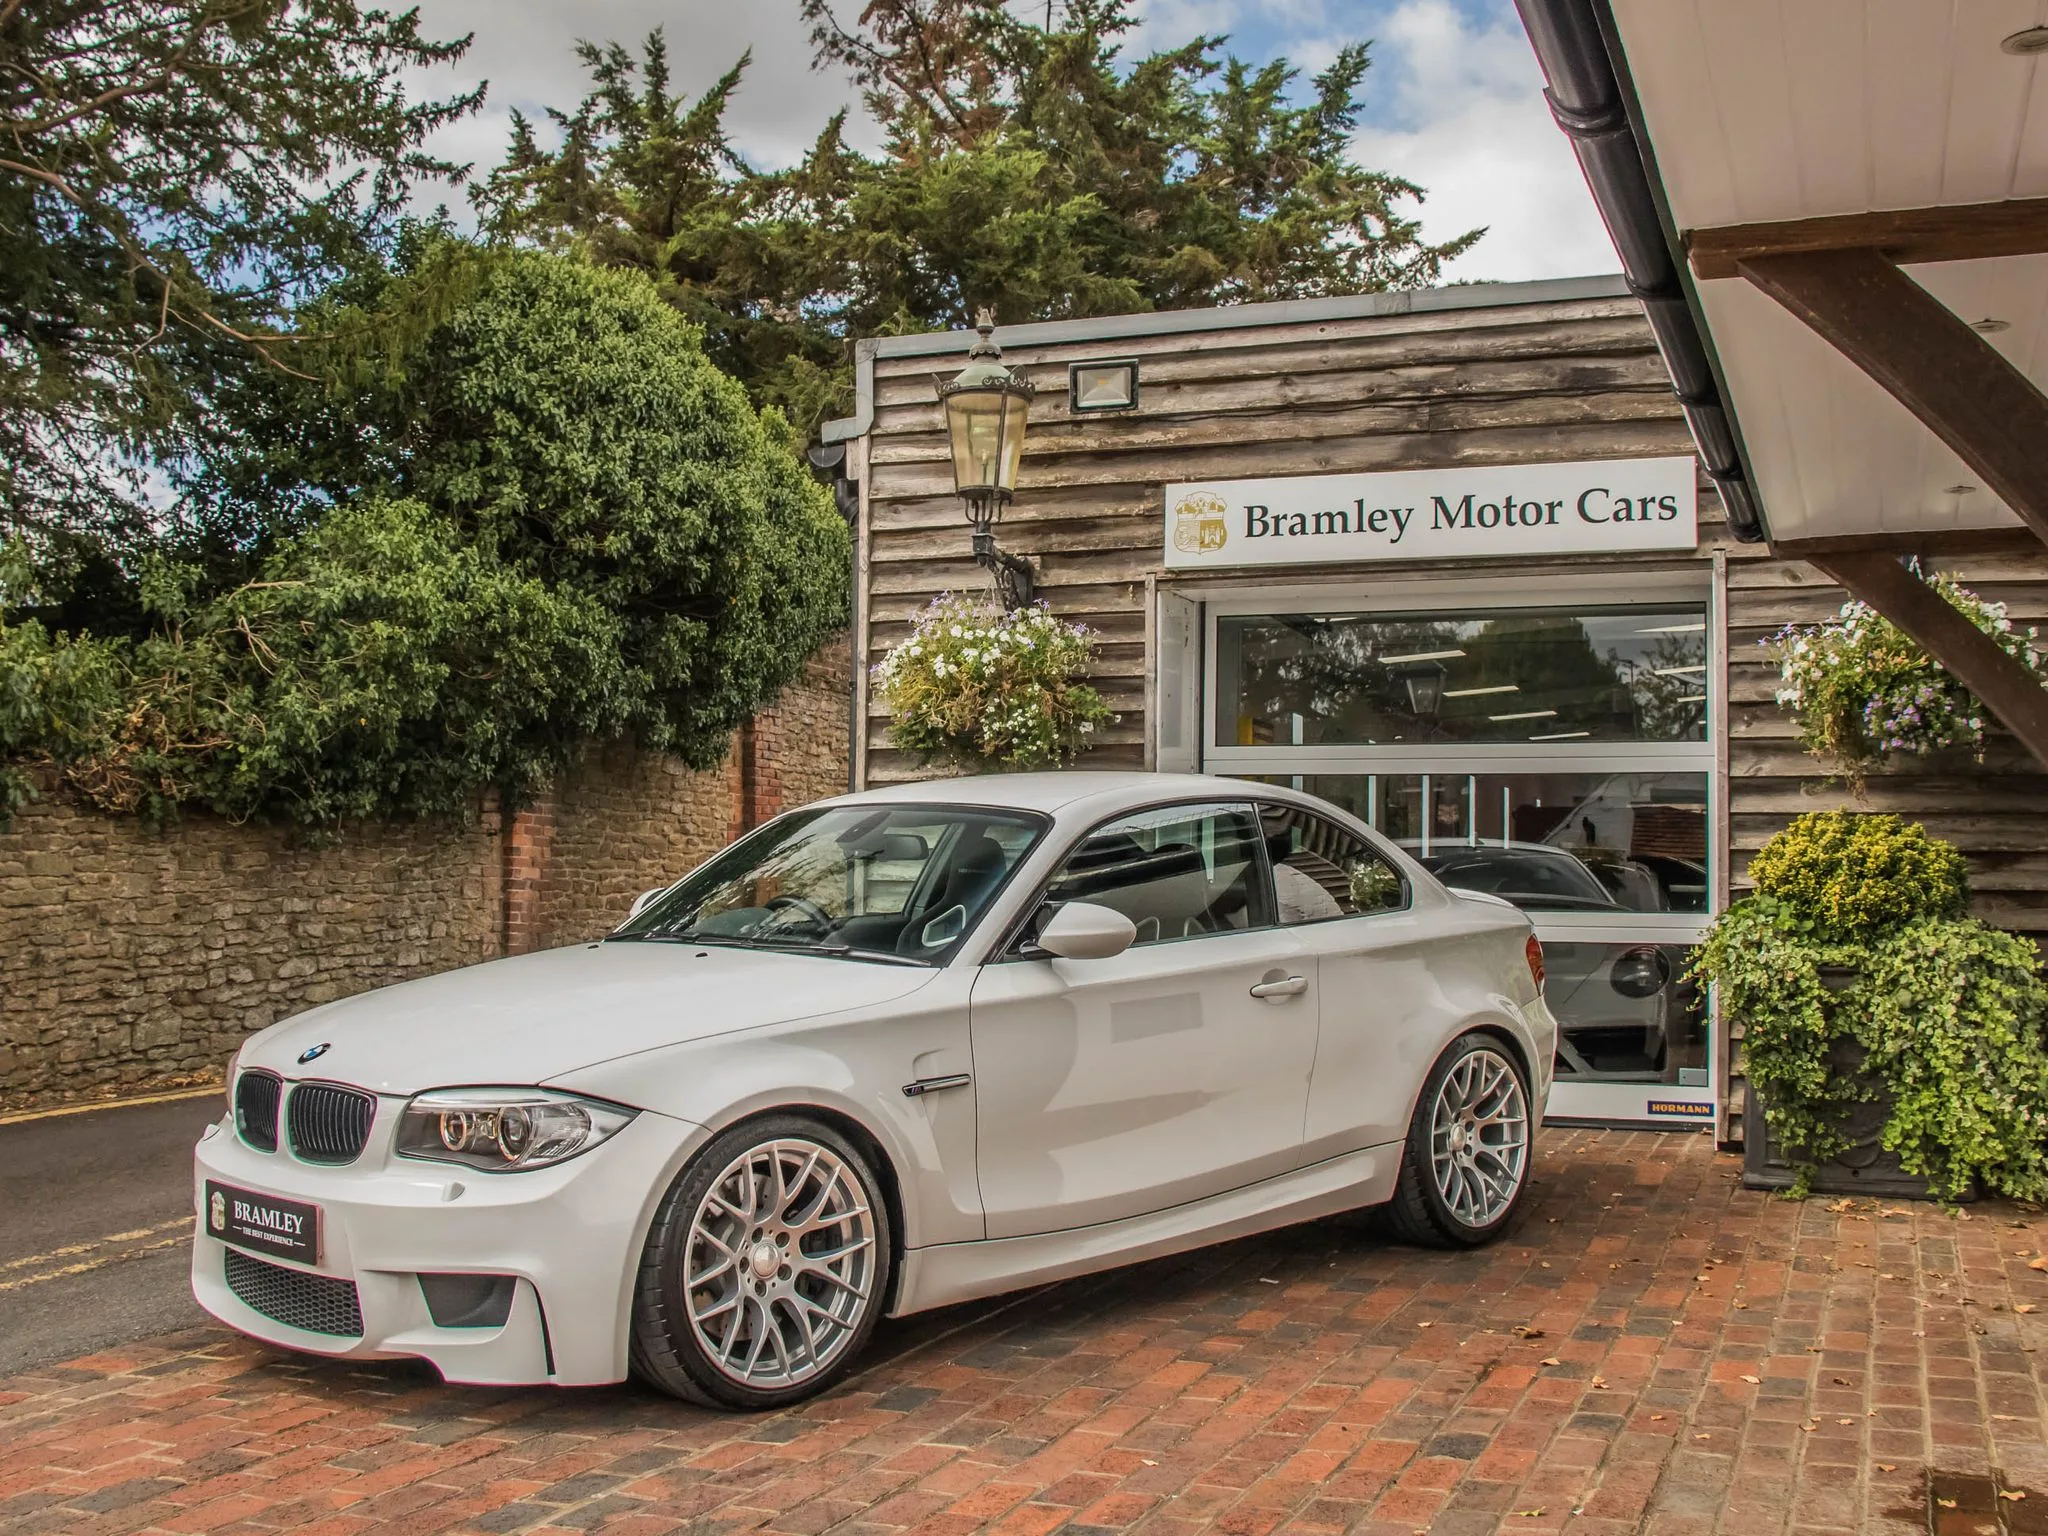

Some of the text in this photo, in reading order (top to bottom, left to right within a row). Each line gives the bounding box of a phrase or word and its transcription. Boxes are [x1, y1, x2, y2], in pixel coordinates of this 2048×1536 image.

[1244, 487, 1679, 544] Bramley Motor Cars
[233, 1200, 304, 1235] BRAMLEY
[252, 1229, 263, 1239] BEST
[263, 1232, 294, 1246] EXPERIENCE
